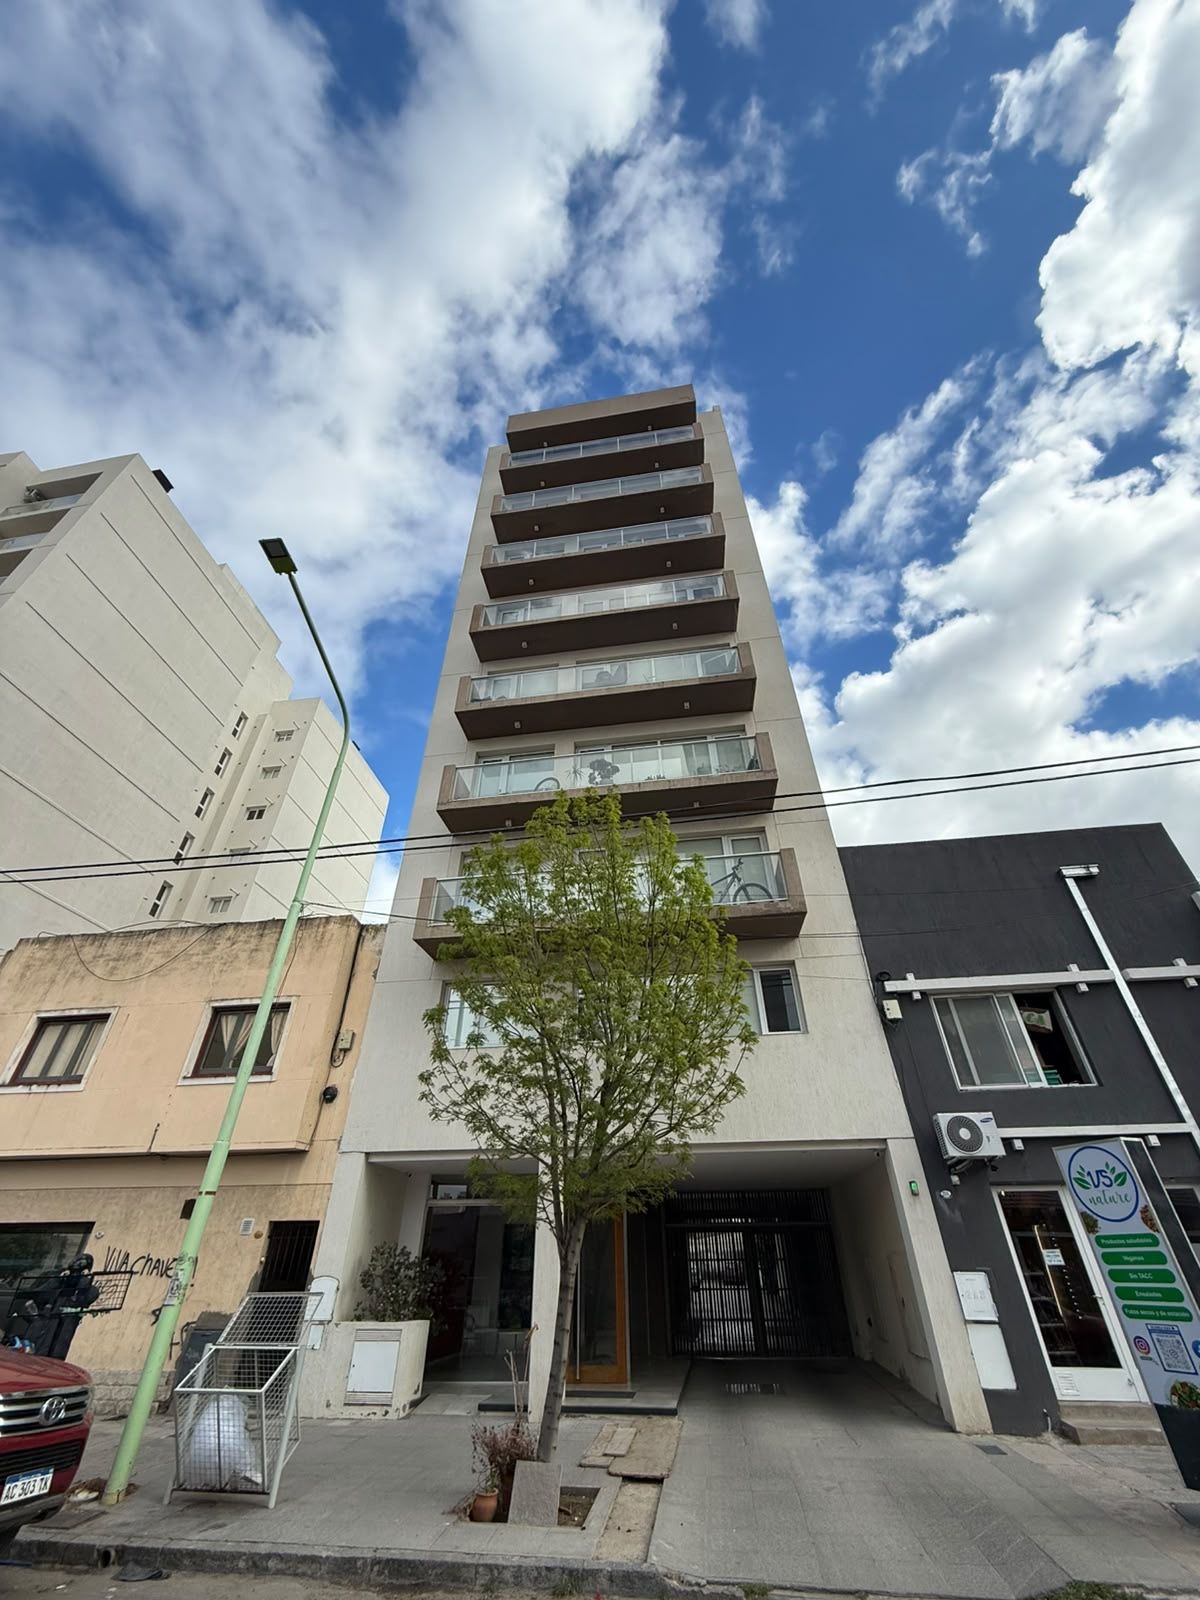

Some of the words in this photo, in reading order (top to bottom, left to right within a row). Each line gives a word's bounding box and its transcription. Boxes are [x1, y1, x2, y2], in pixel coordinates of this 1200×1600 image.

[1088, 1190, 1131, 1206] nature
[4, 1484, 18, 1500] AC
[19, 1479, 37, 1497] 303
